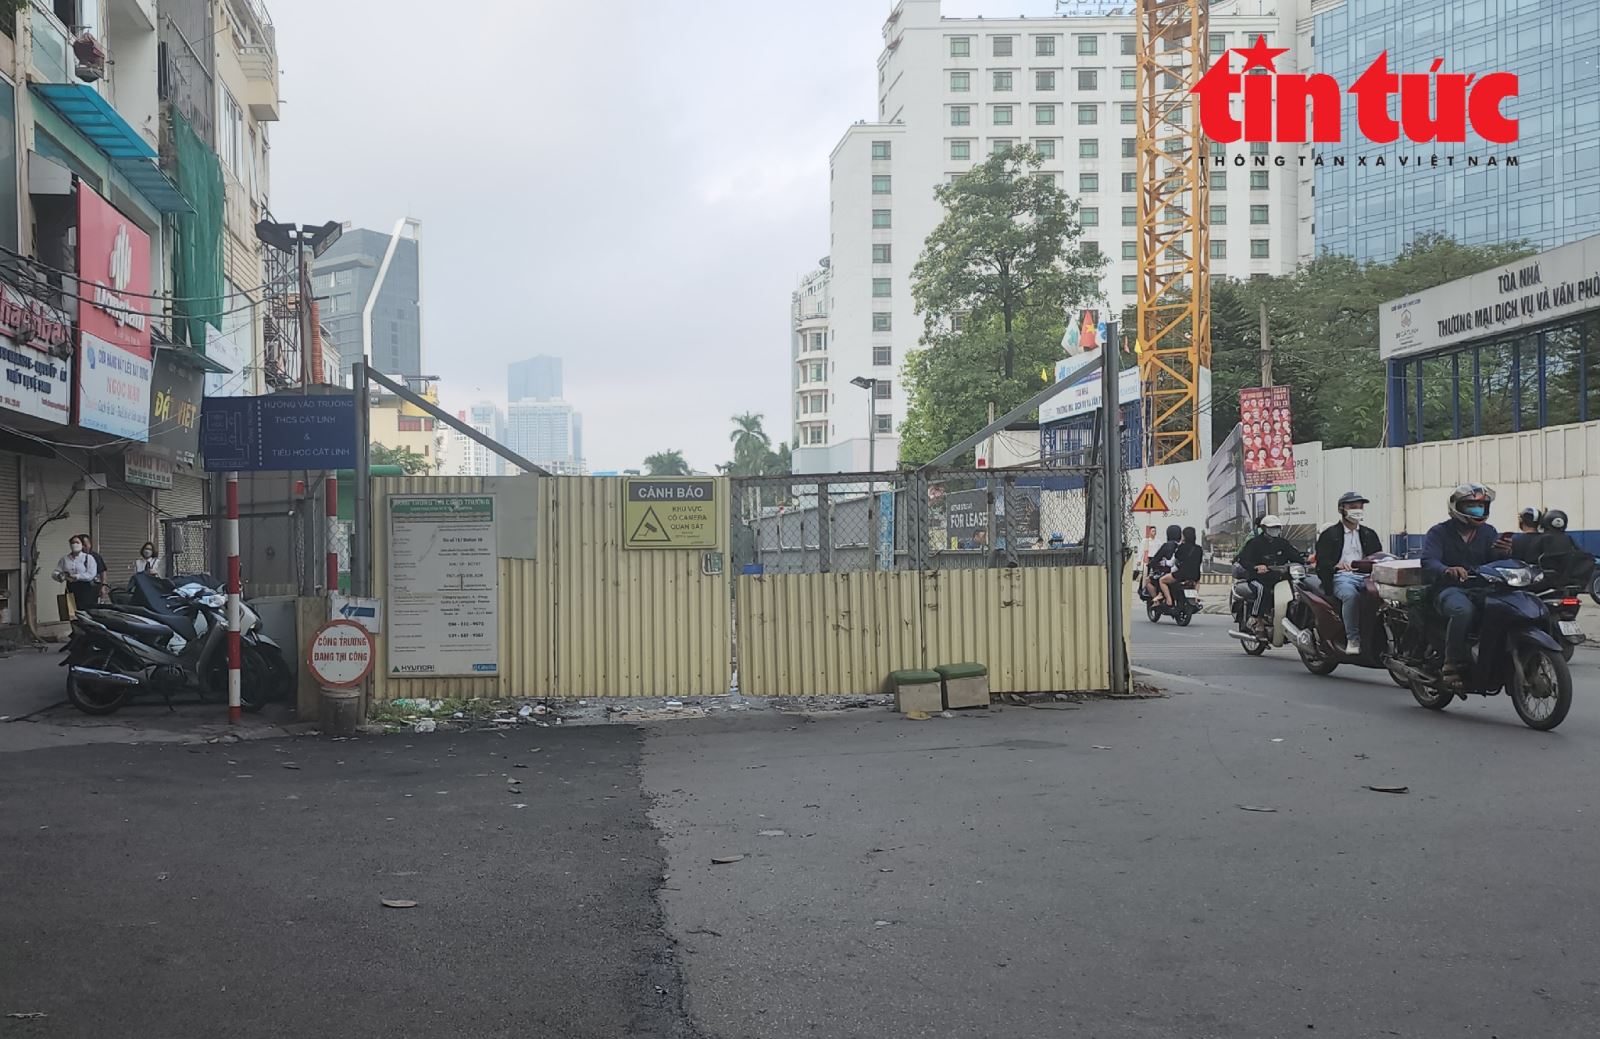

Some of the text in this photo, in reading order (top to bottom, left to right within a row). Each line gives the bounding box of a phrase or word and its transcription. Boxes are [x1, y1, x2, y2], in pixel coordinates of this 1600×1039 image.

[1498, 261, 1542, 294] TÒA NHÀ
[1437, 312, 1473, 338] THƯƠNG
[1474, 307, 1495, 329] MẠI
[1495, 299, 1519, 325] DỊCH
[1521, 294, 1534, 318] VỤ
[1536, 286, 1551, 312] VÀ
[1553, 281, 1576, 308] VĂN
[275, 415, 297, 424] THCS
[299, 414, 316, 424] CÁT
[303, 433, 311, 441] &
[638, 485, 704, 498] CẢNH BÁO
[688, 505, 703, 513] VỰC
[667, 513, 678, 521] CÓ
[951, 511, 988, 528] FOR LEASE
[317, 636, 337, 646] CÔNG
[314, 651, 368, 661] ĐANG THI CÔNG
